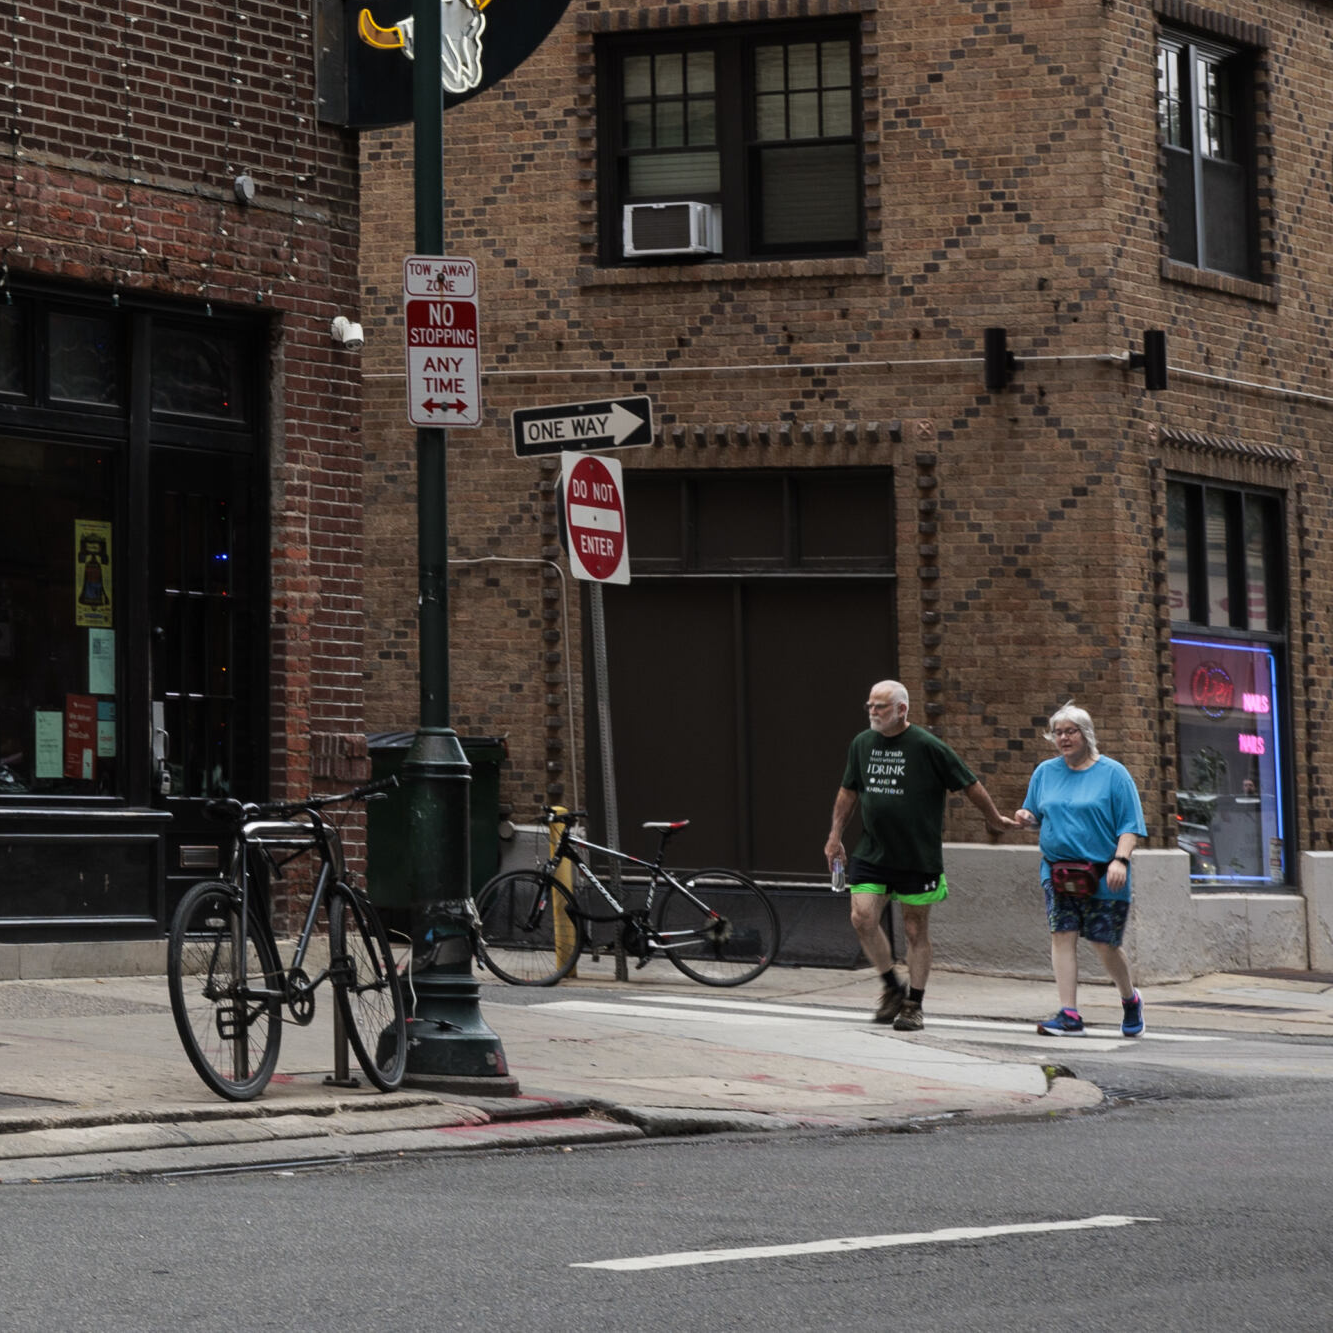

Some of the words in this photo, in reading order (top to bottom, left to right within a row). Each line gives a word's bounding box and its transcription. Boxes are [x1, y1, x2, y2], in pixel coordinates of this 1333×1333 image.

[408, 263, 431, 276] TOW
[426, 279, 456, 292] ZONE
[428, 303, 454, 326] NO
[410, 327, 475, 346] STOPPING
[423, 357, 464, 374] ANY
[423, 377, 467, 394] TIME
[528, 419, 565, 441] ONE
[571, 416, 610, 437] WAY
[572, 479, 588, 499] DO
[592, 481, 615, 503] NOT
[580, 535, 615, 558] ENTER
[872, 763, 906, 776] DRINK
